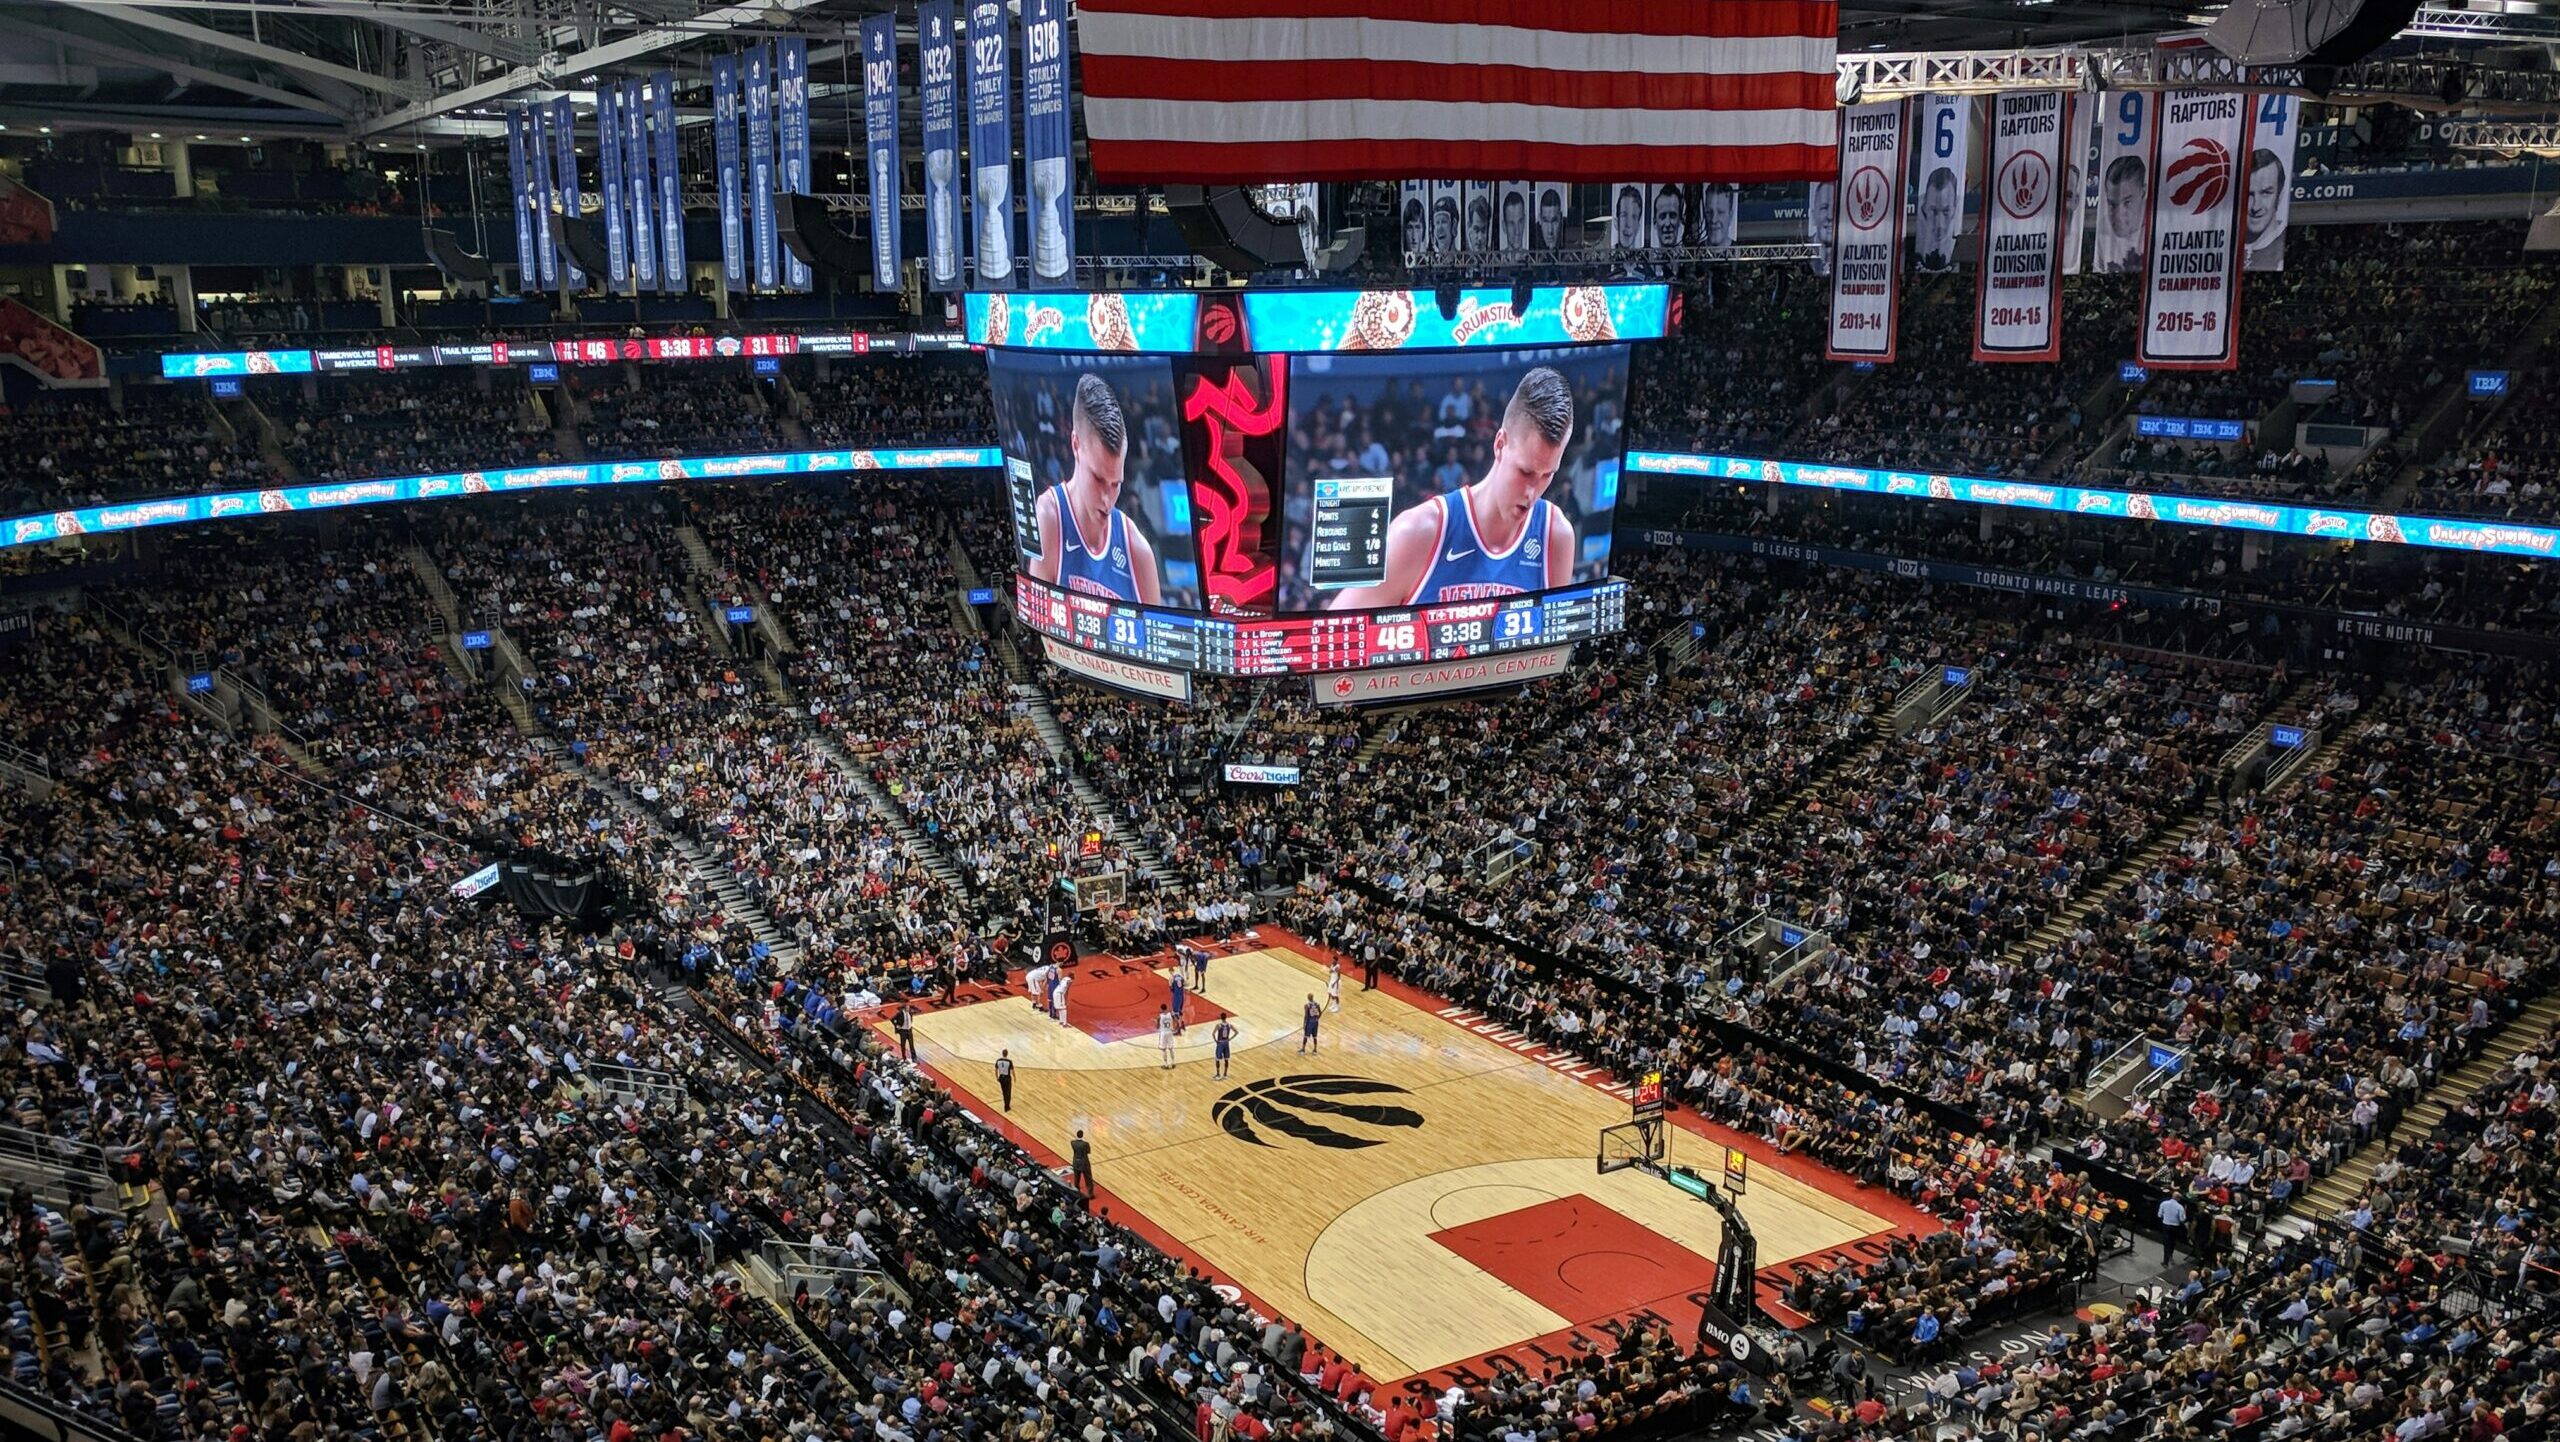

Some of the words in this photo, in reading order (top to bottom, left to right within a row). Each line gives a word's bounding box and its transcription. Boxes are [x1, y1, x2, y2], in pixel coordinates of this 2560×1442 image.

[1028, 19, 1060, 64] 1918
[972, 34, 1003, 75] 922
[924, 45, 952, 84] 1932
[1029, 63, 1061, 84] STANLEY
[926, 84, 951, 103] STANLEY
[1038, 83, 1052, 100] CUP
[933, 103, 944, 117] CUP
[1030, 99, 1062, 116] CHAMPIONS
[2002, 92, 2056, 116] TORONTO
[2170, 98, 2237, 124] RAPTORS
[1850, 113, 1896, 132] TORONTO
[2000, 115, 2055, 137] RAPTORS
[2118, 91, 2143, 146] 9
[1934, 108, 1956, 158] 6
[1848, 134, 1895, 153] RAPTORS
[1995, 232, 2047, 252] ATLANTIC
[2162, 230, 2225, 251] ATLANTIC
[1843, 244, 1887, 260] ATLANTIC
[1993, 252, 2047, 273] DIVISION
[2160, 252, 2223, 274] DIVISION
[1842, 264, 1886, 281] DIVISION
[1841, 283, 1886, 295] CHAMPIONS
[1992, 275, 2045, 290] CHAMPIONS
[2158, 277, 2221, 291] CHAMPIONS
[1839, 312, 1882, 329] 2013-14
[1991, 307, 2041, 326] 2014-15
[2156, 311, 2216, 332] 2015-16
[752, 337, 769, 354] 31
[916, 334, 936, 343] TRAIL
[937, 333, 964, 342] BLAZER
[441, 347, 460, 356] TRAIL
[587, 341, 606, 360] 46
[660, 339, 690, 356] 3:38
[335, 359, 378, 368] MAVERICKS
[757, 361, 776, 370] IBM
[533, 367, 555, 378] IBM
[215, 381, 236, 392] IBM
[2475, 376, 2502, 391] IBM
[2142, 420, 2160, 433] IBM
[2166, 422, 2186, 434] IBM
[2193, 424, 2213, 436] IBM
[2219, 424, 2239, 437] IBM
[1371, 508, 1379, 520] 4
[1370, 523, 1378, 535] 2
[2307, 517, 2347, 534] DRUMSTICK
[1655, 532, 1671, 543] 106
[1366, 553, 1379, 565] 15
[1752, 542, 1765, 553] GO
[1769, 544, 1800, 559] LEAFS
[1806, 548, 1819, 561] GO
[1899, 561, 1917, 573] 107
[1976, 570, 2029, 589] TORONTO
[2035, 579, 2076, 596] MAPLE
[2086, 585, 2128, 602] LEAFS
[730, 611, 748, 620] IBM
[1051, 601, 1067, 627] 46
[1376, 612, 1411, 624] RAPTORS
[1077, 613, 1101, 636] 3:38
[1114, 618, 1138, 645] 31
[1504, 610, 1534, 637] 31
[2337, 619, 2352, 633] WE
[2357, 621, 2382, 637] THE
[2386, 625, 2433, 644] NORTH
[1260, 630, 1284, 638] Brown
[1377, 625, 1416, 651] 46
[1440, 621, 1482, 645] 3:38
[1261, 639, 1283, 648] Lowry
[1240, 649, 1250, 657] 10
[1435, 648, 1449, 660] 24
[1469, 645, 1476, 655] 2
[1074, 652, 1119, 677] CANADA
[1121, 666, 1174, 689] CENTRE
[1240, 658, 1250, 666] 17
[1366, 675, 1400, 691] AIR
[1410, 665, 1487, 687] CANADA
[1495, 653, 1558, 675] CENTRE
[1948, 671, 1966, 683] IBM
[2277, 730, 2300, 745] IBM
[1230, 766, 1265, 781] Coors
[1266, 771, 1298, 783] LIGHT
[1436, 1006, 1547, 1052] NORTH
[1533, 1050, 1602, 1080] THE
[1640, 1085, 1659, 1103] 24
[1705, 1322, 1730, 1345] BMO
